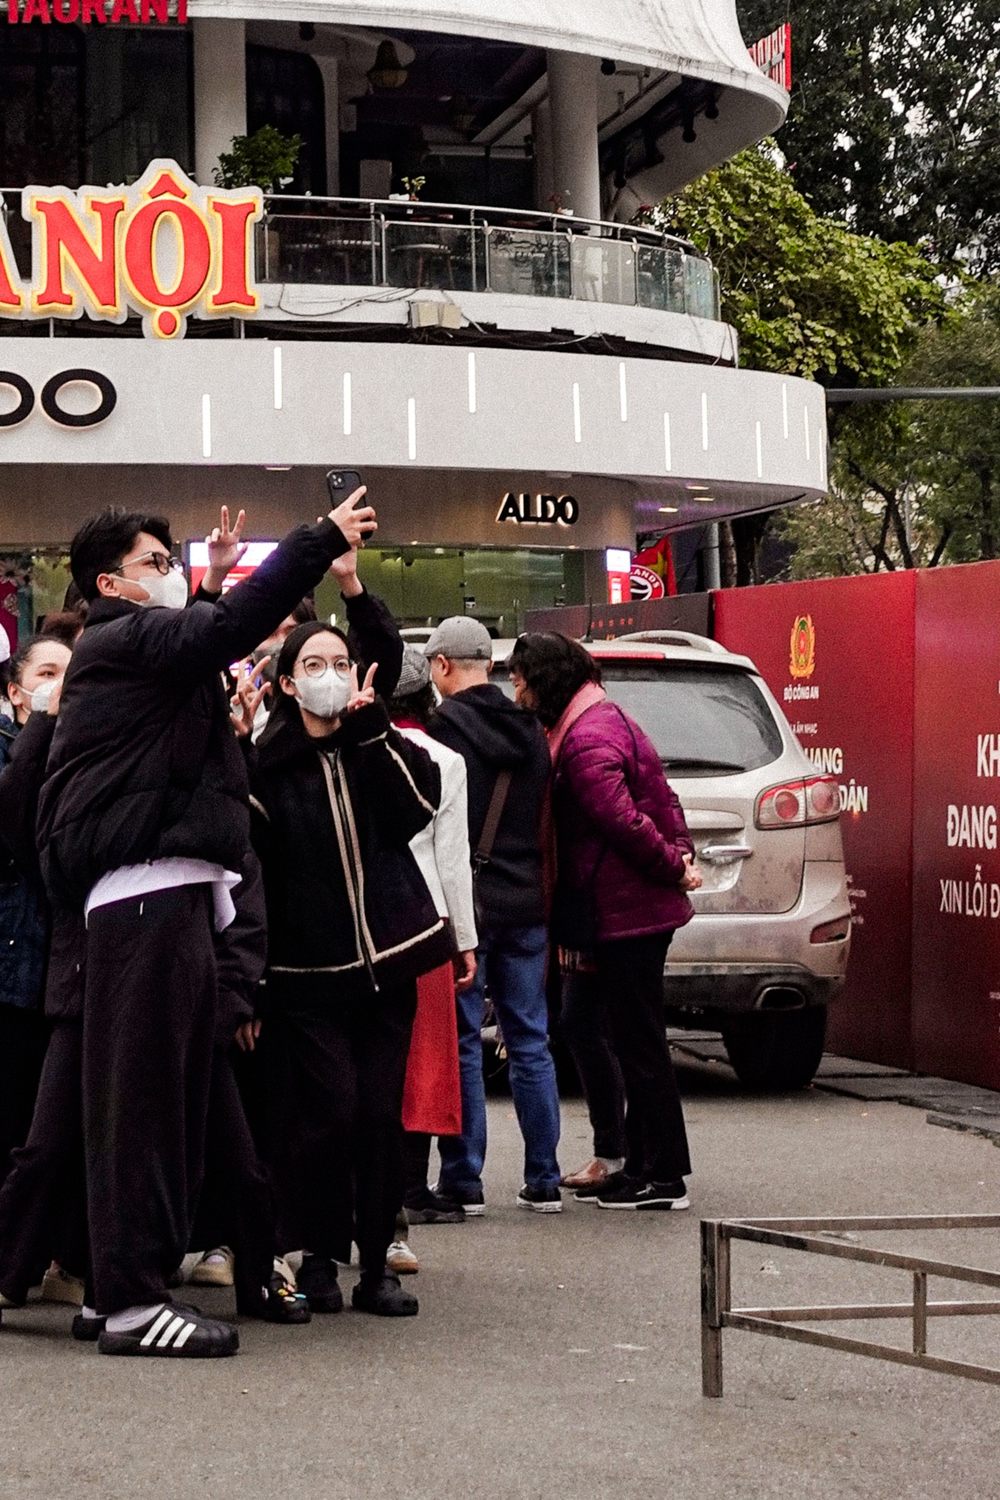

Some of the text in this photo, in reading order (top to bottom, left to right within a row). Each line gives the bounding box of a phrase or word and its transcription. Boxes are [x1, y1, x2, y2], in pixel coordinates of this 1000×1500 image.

[29, 168, 263, 338] NỘI
[496, 492, 579, 527] ALDO
[630, 569, 660, 589] ANDS
[947, 805, 997, 849] ĐANG
[940, 879, 963, 913] XIN
[966, 864, 987, 917] LỖI
